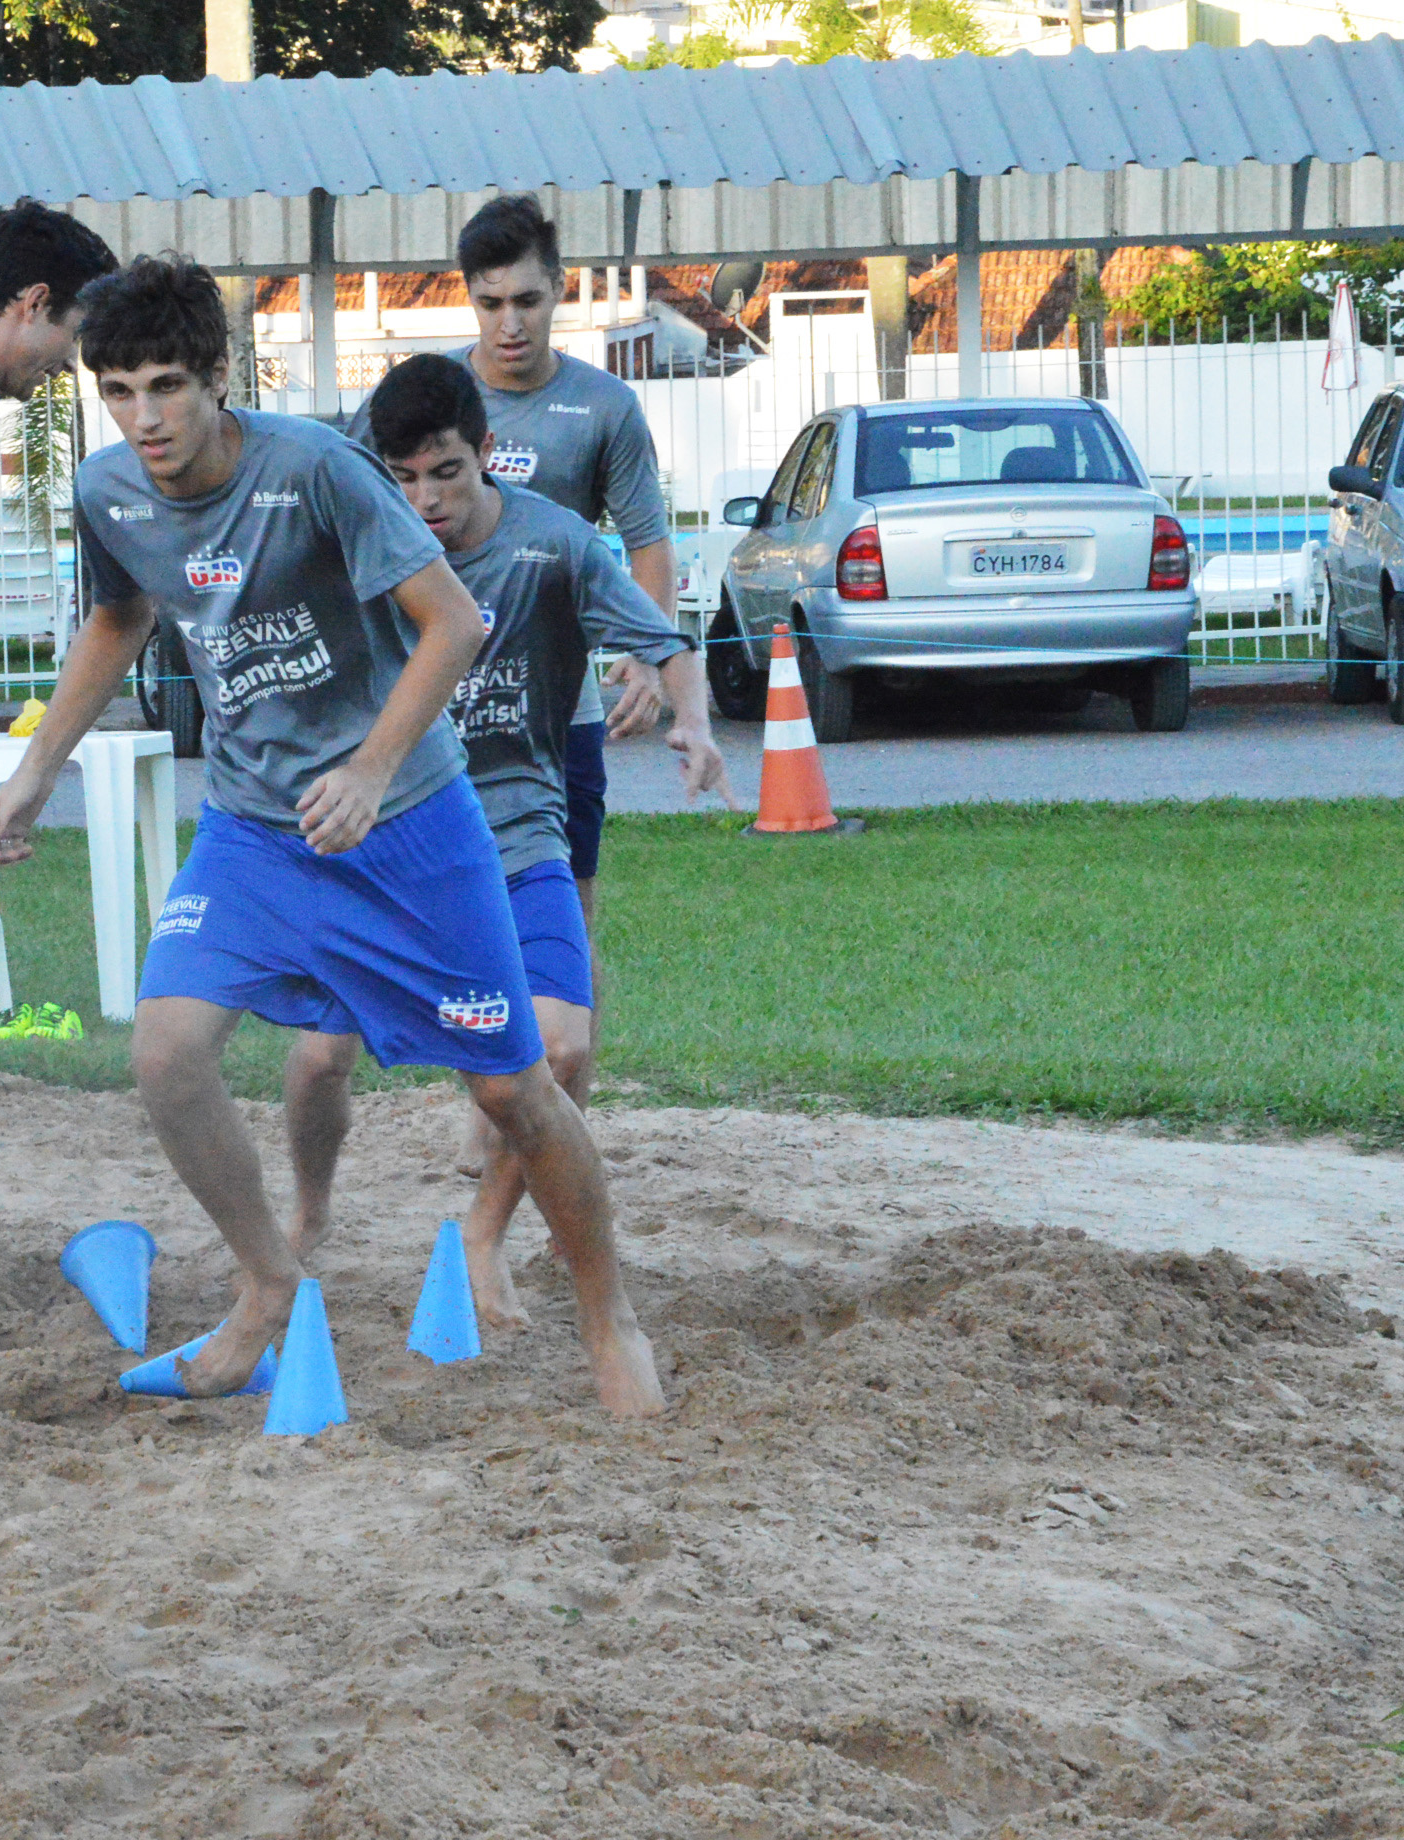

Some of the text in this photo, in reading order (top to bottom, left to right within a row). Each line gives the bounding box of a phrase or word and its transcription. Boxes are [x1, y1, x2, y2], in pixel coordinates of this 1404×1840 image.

[202, 602, 308, 637] UNIVERSIDADE
[243, 684, 283, 706] sempre
[165, 900, 208, 912] FEEVALE
